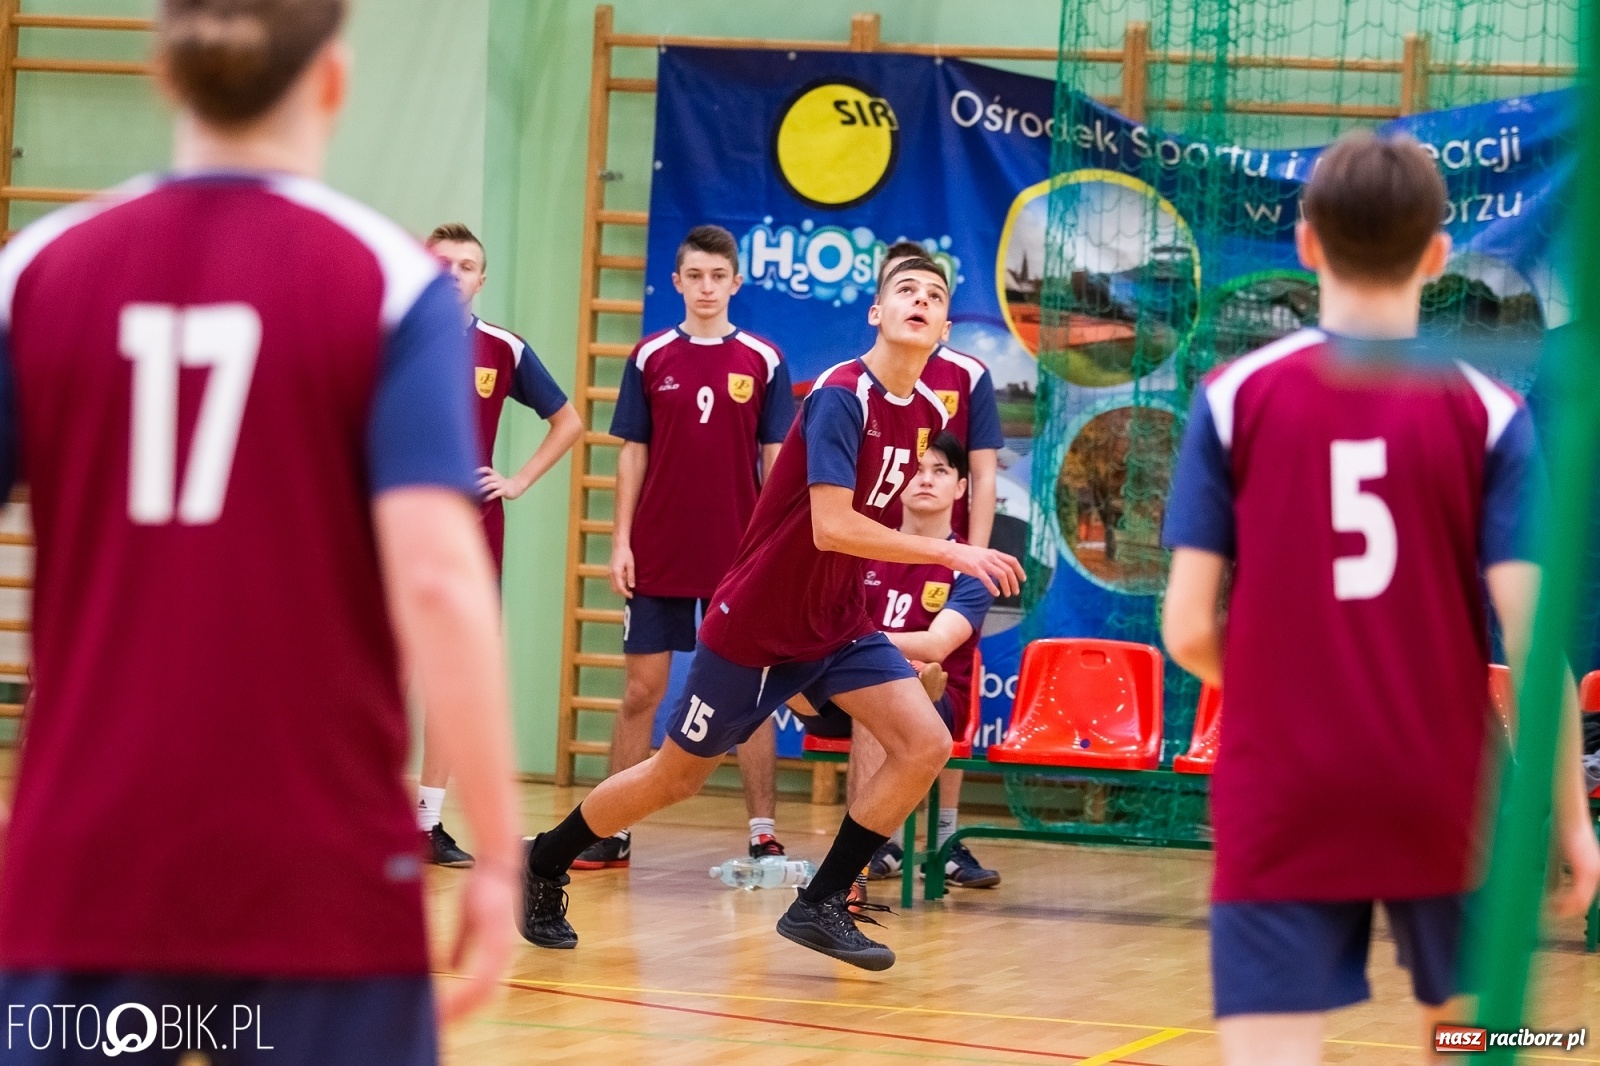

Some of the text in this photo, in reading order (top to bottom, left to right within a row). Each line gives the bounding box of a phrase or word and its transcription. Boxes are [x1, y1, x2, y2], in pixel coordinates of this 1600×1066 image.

[951, 89, 1119, 155] Ośrodek
[1284, 150, 1300, 181] i
[117, 302, 264, 526] 17
[696, 386, 715, 424] 9
[865, 445, 911, 508] 15
[1330, 436, 1398, 600] 5
[882, 589, 913, 628] 12
[680, 694, 716, 742] 15
